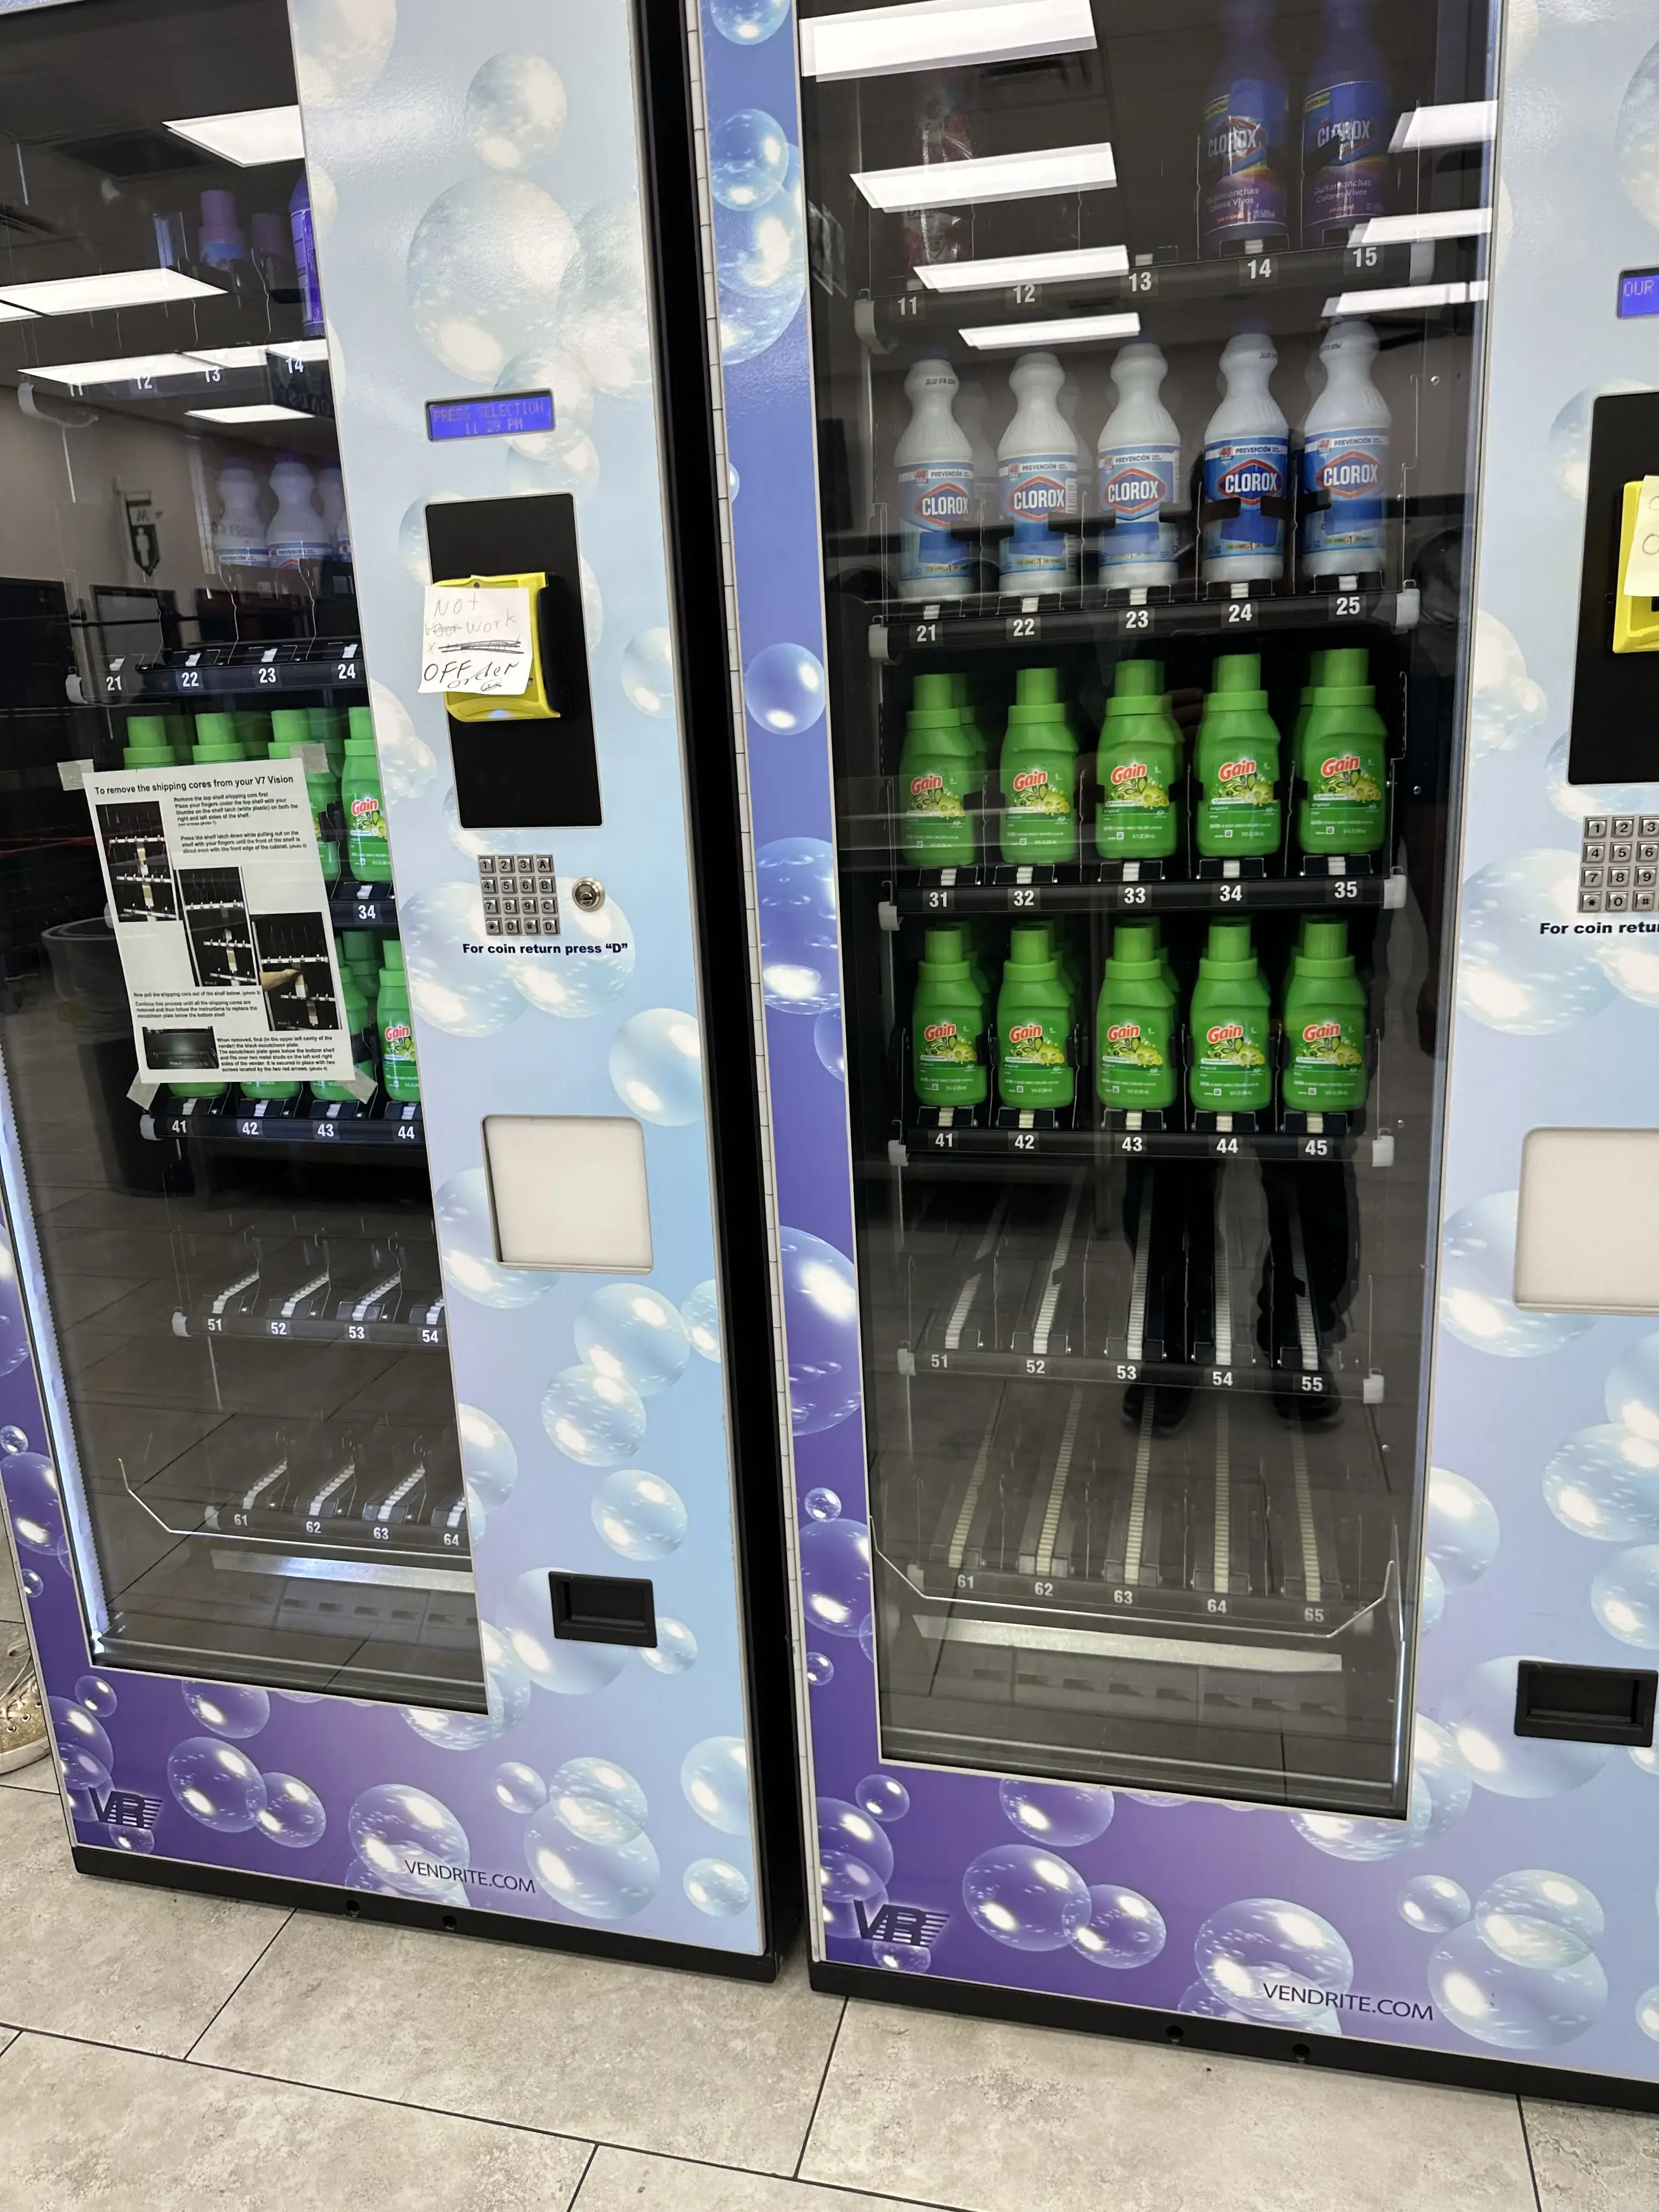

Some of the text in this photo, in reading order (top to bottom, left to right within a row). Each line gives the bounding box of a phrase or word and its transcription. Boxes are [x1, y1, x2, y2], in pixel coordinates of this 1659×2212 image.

[1352, 247, 1377, 267] 15
[1248, 258, 1272, 279] 14
[1128, 272, 1152, 292] 13
[1013, 285, 1036, 303] 12
[898, 297, 917, 315] 11
[285, 359, 304, 373] 14
[135, 375, 153, 390] 12
[205, 368, 221, 382] 13
[434, 400, 544, 422] PRESS SELECTION
[507, 418, 523, 430] PM
[1235, 446, 1271, 454] PREVENCIÓN
[1334, 438, 1372, 447] PREVENCIÓN
[1115, 454, 1150, 463] PREVENCIÓN
[930, 470, 963, 478] PREVENCIÓN
[1324, 463, 1378, 487] CLOROX
[1225, 472, 1277, 493] CLOROX
[1108, 480, 1158, 503] CLOROX
[922, 496, 968, 516] CLOROX
[1014, 489, 1065, 510] CLOROX
[1228, 603, 1252, 622] 24
[1336, 597, 1361, 615] 25
[1013, 618, 1035, 636] 22
[1126, 611, 1148, 629] 23
[917, 624, 936, 642] 21
[182, 672, 199, 687] 22
[258, 668, 276, 683] 23
[338, 664, 356, 680] 24
[106, 676, 122, 691] 21
[1218, 760, 1256, 781] Gain
[1321, 755, 1360, 777] Gain
[1014, 770, 1048, 791] Gain
[1111, 764, 1147, 785] Gain
[153, 782, 187, 793] shipping
[214, 779, 233, 787] from
[235, 778, 253, 788] your
[255, 776, 266, 785] V7
[268, 775, 294, 783] Vision
[911, 775, 943, 794] Gain
[352, 799, 379, 816] Gain
[274, 830, 283, 838] out
[1595, 822, 1655, 833] 1 2 3
[1591, 848, 1653, 857] 4 5 6
[501, 861, 507, 869] 2
[520, 861, 526, 869] 3
[539, 860, 546, 868] A
[1590, 872, 1651, 882] 7 8 9
[1124, 887, 1146, 904] 33
[1220, 885, 1242, 901] 34
[1334, 881, 1357, 898] 35
[929, 891, 948, 907] 31
[1014, 890, 1034, 906] 32
[1613, 897, 1623, 906] 0
[358, 904, 376, 920] 34
[487, 902, 492, 911] 7
[1539, 921, 1659, 934] For coin retu
[462, 943, 483, 953] For
[488, 944, 515, 953] coin
[520, 944, 561, 953] return
[565, 944, 602, 956] press
[385, 1026, 410, 1041] Gain
[924, 1023, 956, 1041] Gain
[1009, 1023, 1042, 1042] Gain
[1107, 1025, 1141, 1042] Gain
[1207, 1025, 1243, 1044] Gain
[1303, 1023, 1340, 1042] Gain
[172, 1120, 187, 1133] 41
[241, 1122, 259, 1135] 42
[317, 1124, 334, 1137] 43
[397, 1125, 415, 1139] 44
[935, 1133, 953, 1147] 41
[1014, 1135, 1034, 1149] 42
[1122, 1137, 1143, 1152] 43
[1216, 1138, 1238, 1153] 44
[1305, 1139, 1327, 1155] 45
[208, 1319, 222, 1331] 51
[271, 1323, 287, 1335] 52
[348, 1326, 365, 1339] 53
[422, 1329, 439, 1342] 54
[930, 1354, 949, 1368] 51
[1026, 1359, 1046, 1374] 52
[1116, 1365, 1137, 1380] 53
[1212, 1371, 1233, 1386] 54
[1301, 1376, 1323, 1391] 55
[234, 1514, 248, 1526] 61
[306, 1521, 321, 1533] 62
[373, 1528, 389, 1540] 63
[443, 1533, 459, 1546] 64
[957, 1574, 975, 1589] 61
[1034, 1582, 1053, 1596] 62
[1114, 1590, 1133, 1604] 63
[1207, 1599, 1227, 1613] 64
[1304, 1607, 1324, 1622] 65
[404, 1860, 536, 1893] VENDRITE.COM
[1263, 1983, 1434, 2021] VENDRITE.COM
